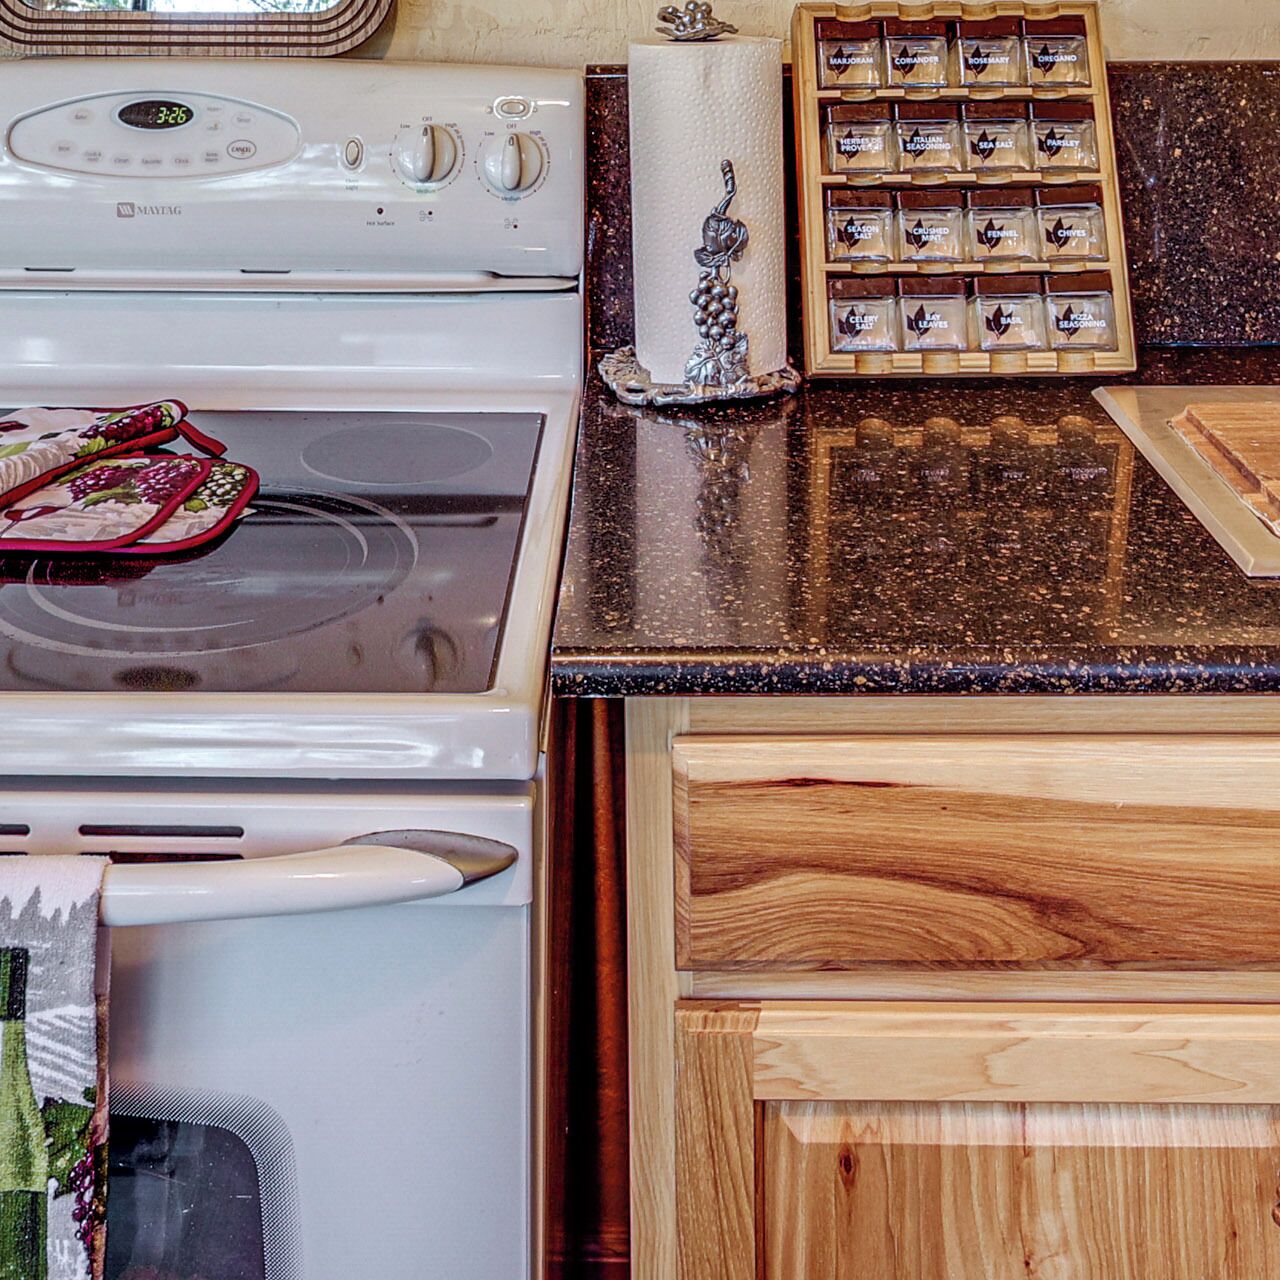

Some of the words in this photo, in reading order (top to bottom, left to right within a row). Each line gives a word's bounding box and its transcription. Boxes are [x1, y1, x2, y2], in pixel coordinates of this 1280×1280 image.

[830, 56, 874, 65] MARJORAM
[895, 55, 939, 65] CORIANDER
[968, 55, 1010, 65] ROSEMARY
[1038, 54, 1077, 63] OREGANO
[156, 107, 187, 124] 3:26
[840, 137, 869, 145] HERBES
[913, 136, 942, 144] ITALIAN
[1046, 139, 1080, 148] PARSLEY
[906, 143, 951, 151] SEASONING
[979, 141, 994, 149] SEA
[996, 140, 1014, 149] SALT
[136, 206, 182, 215] MAYTAG
[847, 225, 879, 234] SEASON
[913, 227, 949, 235] CRUSHED
[1057, 229, 1087, 237] CHIVES
[922, 234, 940, 242] MINT
[987, 230, 1018, 238] FENNEL
[850, 315, 879, 323] CELERY
[1000, 316, 1023, 325] BASIL
[1070, 313, 1093, 321] PIZZA
[855, 322, 873, 330] SALT
[919, 320, 949, 329] LEAVES
[1059, 320, 1106, 328] SEASONING
